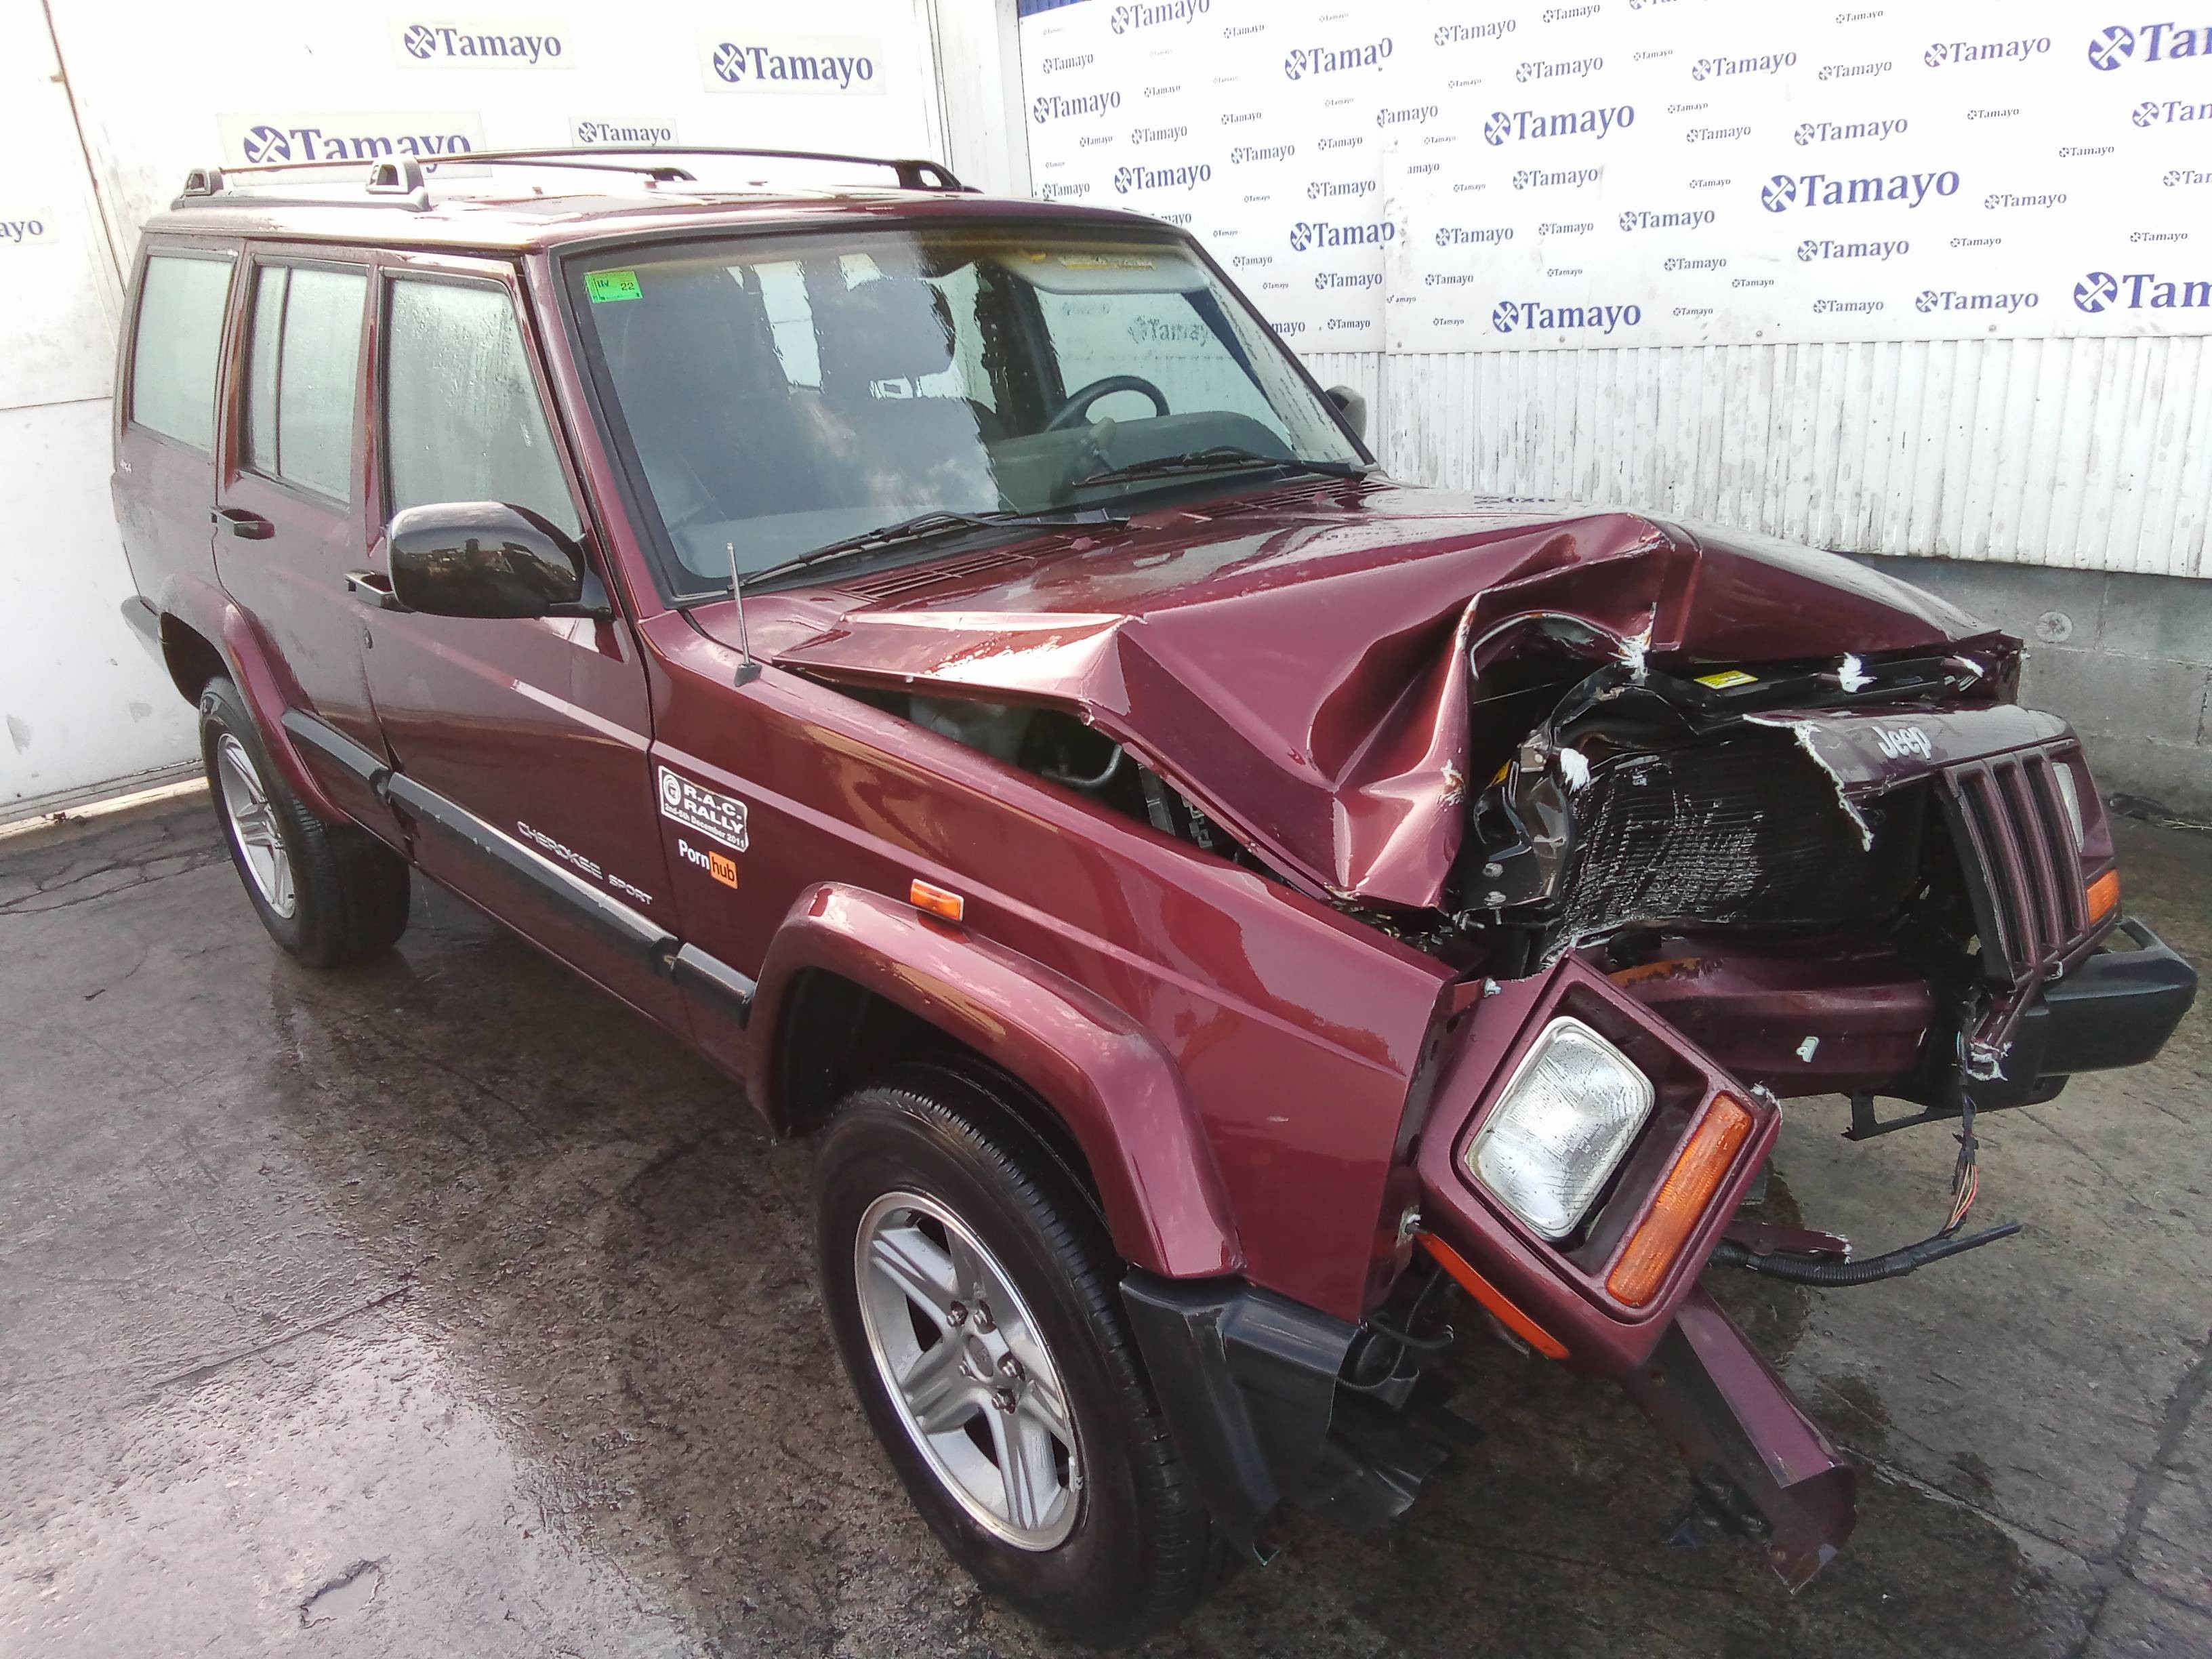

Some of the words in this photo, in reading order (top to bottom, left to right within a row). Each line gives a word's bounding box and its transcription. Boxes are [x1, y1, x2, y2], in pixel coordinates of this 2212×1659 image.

[1130, 0, 1210, 28] Tamayo
[1553, 3, 1601, 20] Tamayo
[1847, 10, 1883, 22] Tamayo
[1233, 24, 1265, 37] Tamayo
[1448, 19, 1516, 42] Tamayo
[434, 28, 562, 64] Tamayo
[1642, 49, 1673, 60] Tamayo
[1949, 37, 2051, 63] Tamayo
[746, 47, 873, 90] Tamayo
[1052, 54, 1094, 70] Tamayo
[1533, 57, 1603, 79] Tamayo
[1713, 52, 1797, 77] Tamayo
[1832, 61, 1892, 79] Tamayo
[1049, 91, 1121, 119] Tamayo
[1677, 102, 1708, 112] Tamayo
[1978, 108, 2020, 119] Tamayo
[2161, 100, 2212, 123] Tam
[1230, 112, 1262, 123] Tamayo
[1380, 105, 1438, 125] Tamayo
[1513, 105, 1635, 140] Tamayo
[597, 123, 671, 146] Tamayo
[1142, 125, 1187, 142] Tamayo
[1699, 126, 1751, 141] Tamayo
[1816, 119, 1908, 142] Tamayo
[1328, 137, 1363, 148] Tamayo
[2070, 146, 2114, 157] Tamayo
[1243, 145, 1295, 162] Tamayo
[1132, 164, 1211, 191] Tamayo
[1407, 163, 1440, 176] amayo
[1529, 169, 1598, 188] Tamayo
[2182, 170, 2212, 185] Tam
[1052, 182, 1090, 197] Tamayo
[1320, 180, 1376, 198] Tamayo
[1698, 179, 1731, 188] Tamayo
[1799, 171, 1960, 209] Tamayo
[2001, 194, 2067, 209] Tamayo
[1161, 213, 1191, 226] mayo
[1549, 222, 1594, 235] Tamayo
[1638, 210, 1715, 230] Tamayo
[0, 220, 43, 243] ayo
[1450, 228, 1514, 246] Tamayo
[2142, 232, 2188, 243] Tamayo
[1819, 240, 1910, 262] Tamayo
[1961, 238, 2002, 247] Tamayo
[1242, 256, 1273, 267] Tamayo
[1676, 258, 1727, 272] Tamayo
[1328, 272, 1382, 290] Tamayo
[1434, 274, 1474, 287] Tamayo
[1740, 279, 1774, 288] Tamayo
[2122, 273, 2212, 309] Tam
[1826, 300, 1884, 314] Tamayo
[1940, 291, 2039, 314] Tamayo
[1520, 302, 1641, 335] Tamayo
[1681, 307, 1713, 318] Tamayo
[1271, 321, 1306, 336] mayo
[1336, 319, 1371, 331] Tamayo
[1871, 726, 1932, 760] Jeep
[684, 783, 743, 820] R.A.C.
[684, 798, 744, 834] RALLY
[691, 815, 726, 839] December
[726, 833, 745, 848] 2011
[517, 821, 604, 880] CHEROKEE
[609, 874, 653, 905] SPORT
